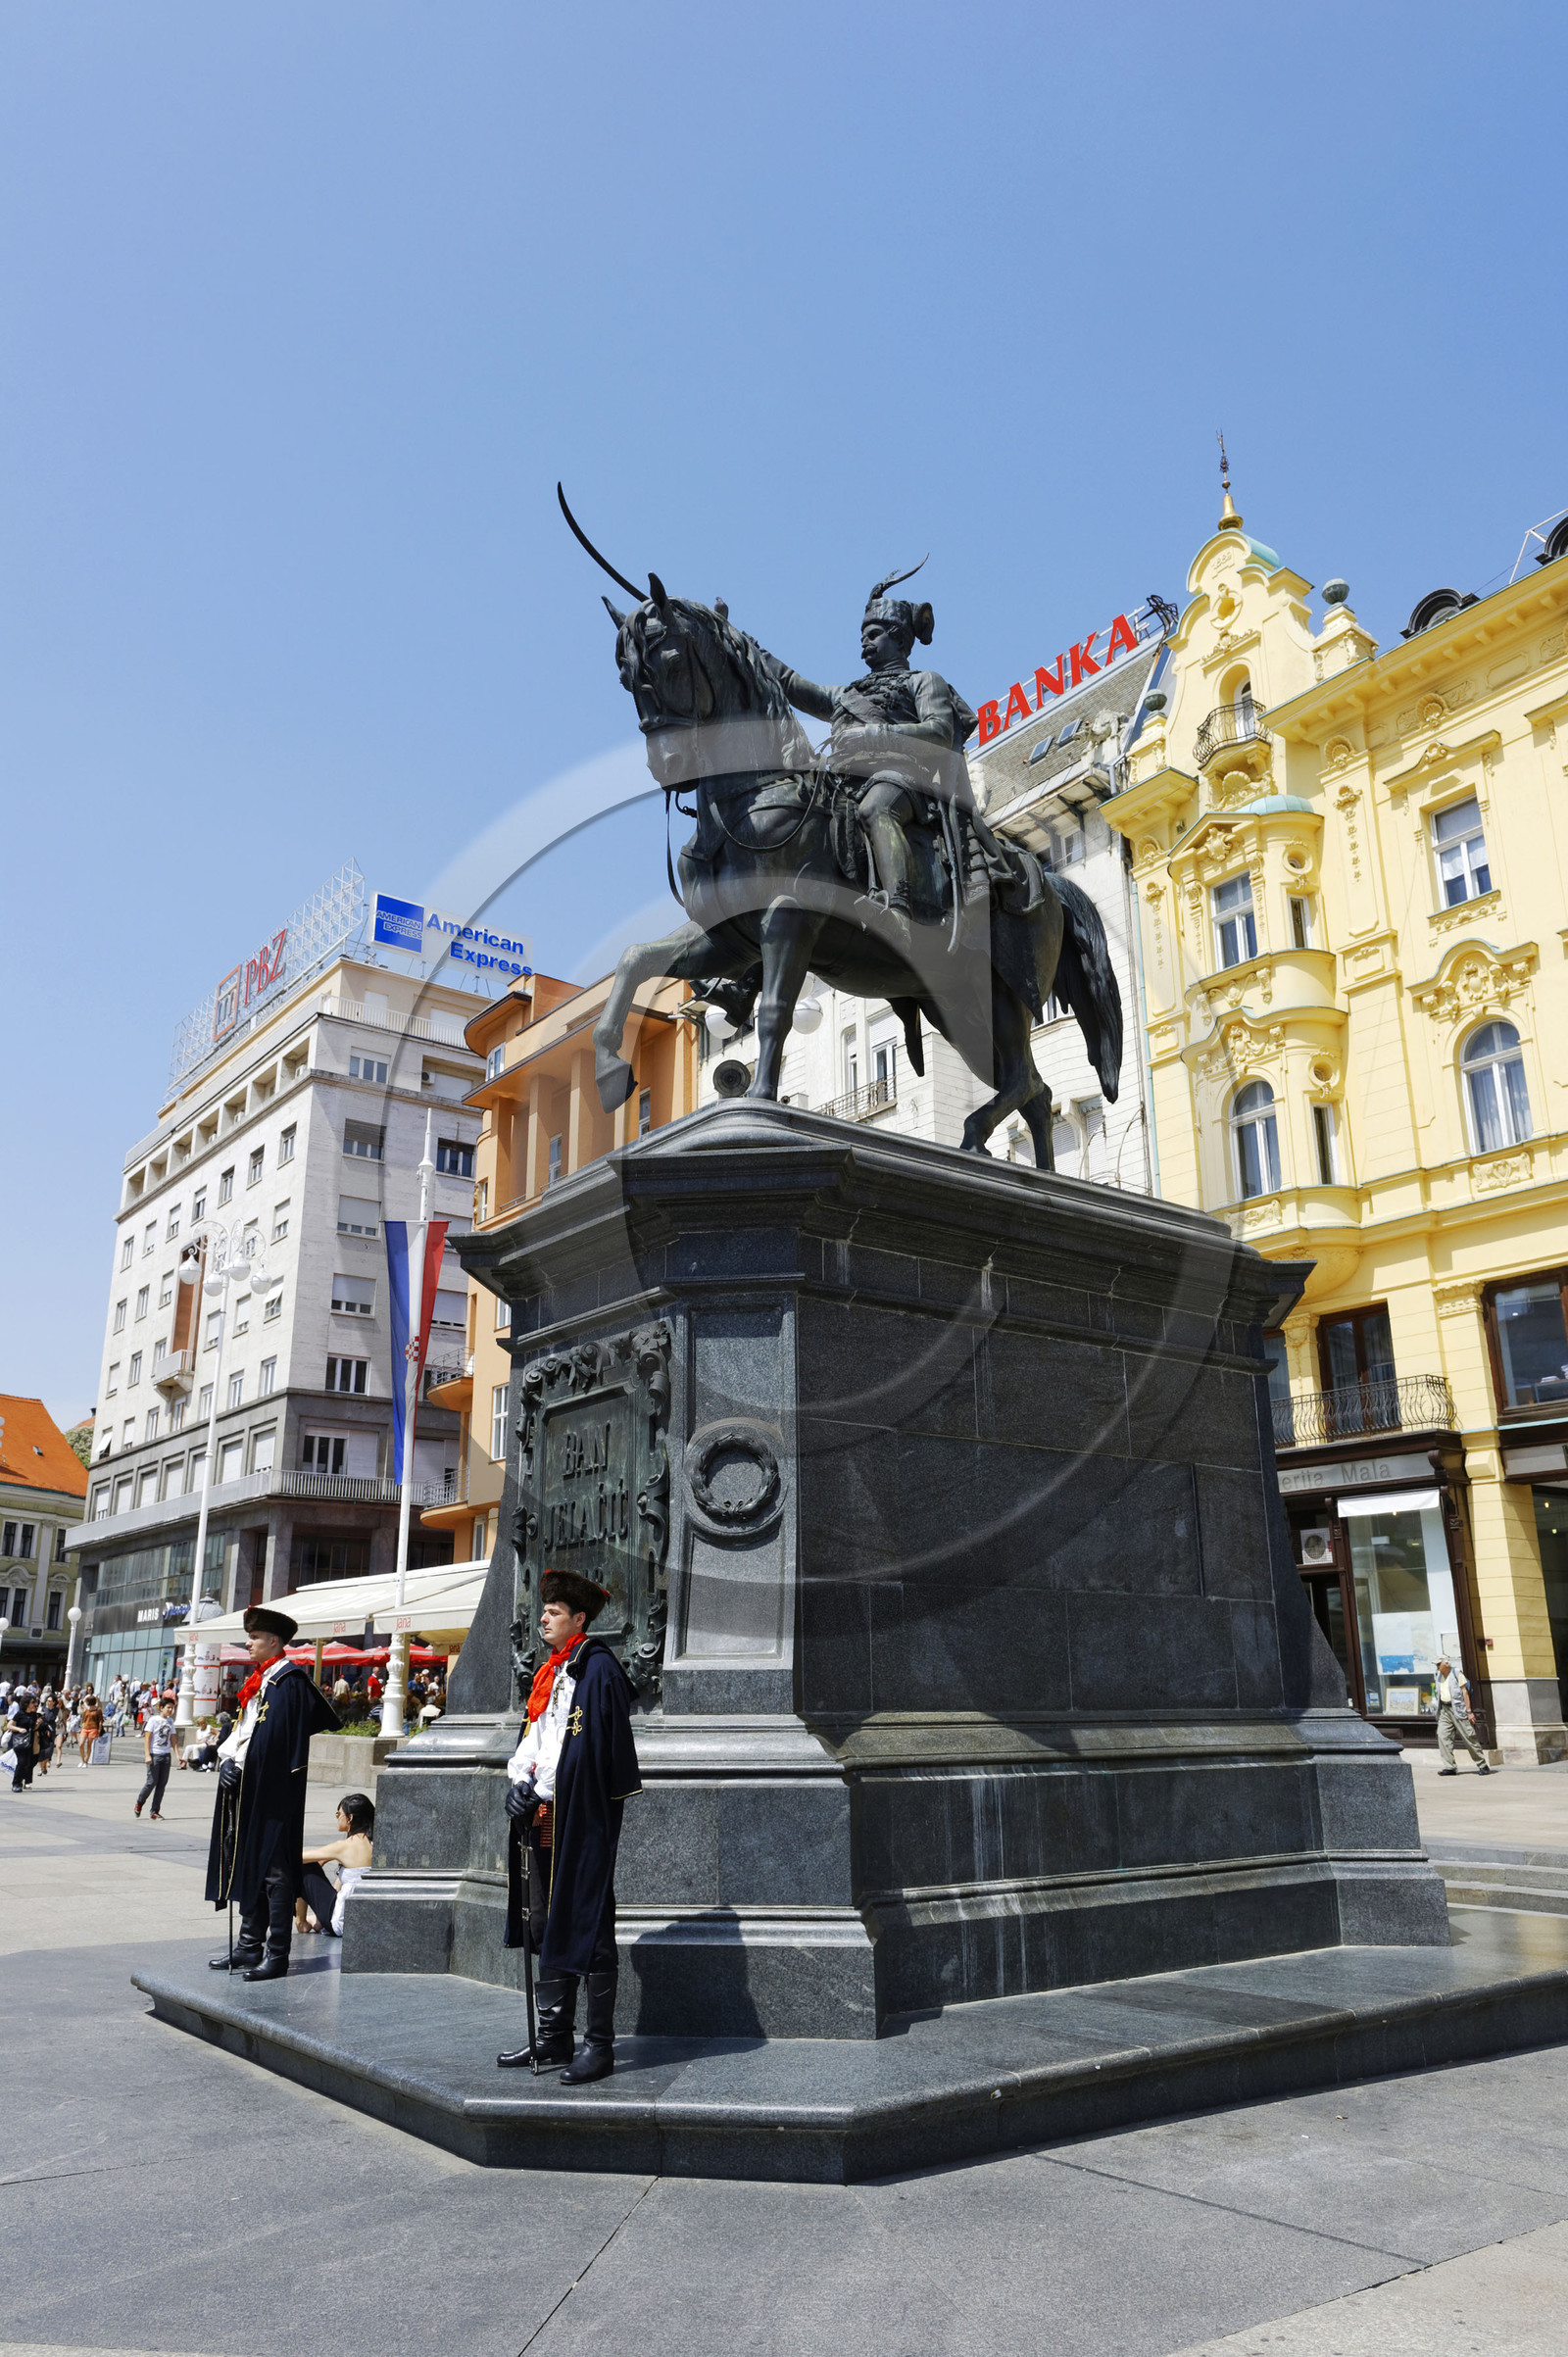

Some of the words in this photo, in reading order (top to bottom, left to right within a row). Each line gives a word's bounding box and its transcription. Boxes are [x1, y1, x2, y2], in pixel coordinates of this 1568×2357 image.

[977, 614, 1139, 747] BANKA
[376, 909, 422, 930] AMERICAN
[383, 921, 422, 939] EXPRESS
[426, 912, 524, 955] American
[244, 928, 288, 1007] PBZ
[450, 941, 533, 976] Express
[563, 1421, 612, 1480] BAN
[1341, 1459, 1392, 1484] Mala
[137, 1607, 160, 1623] MARIS
